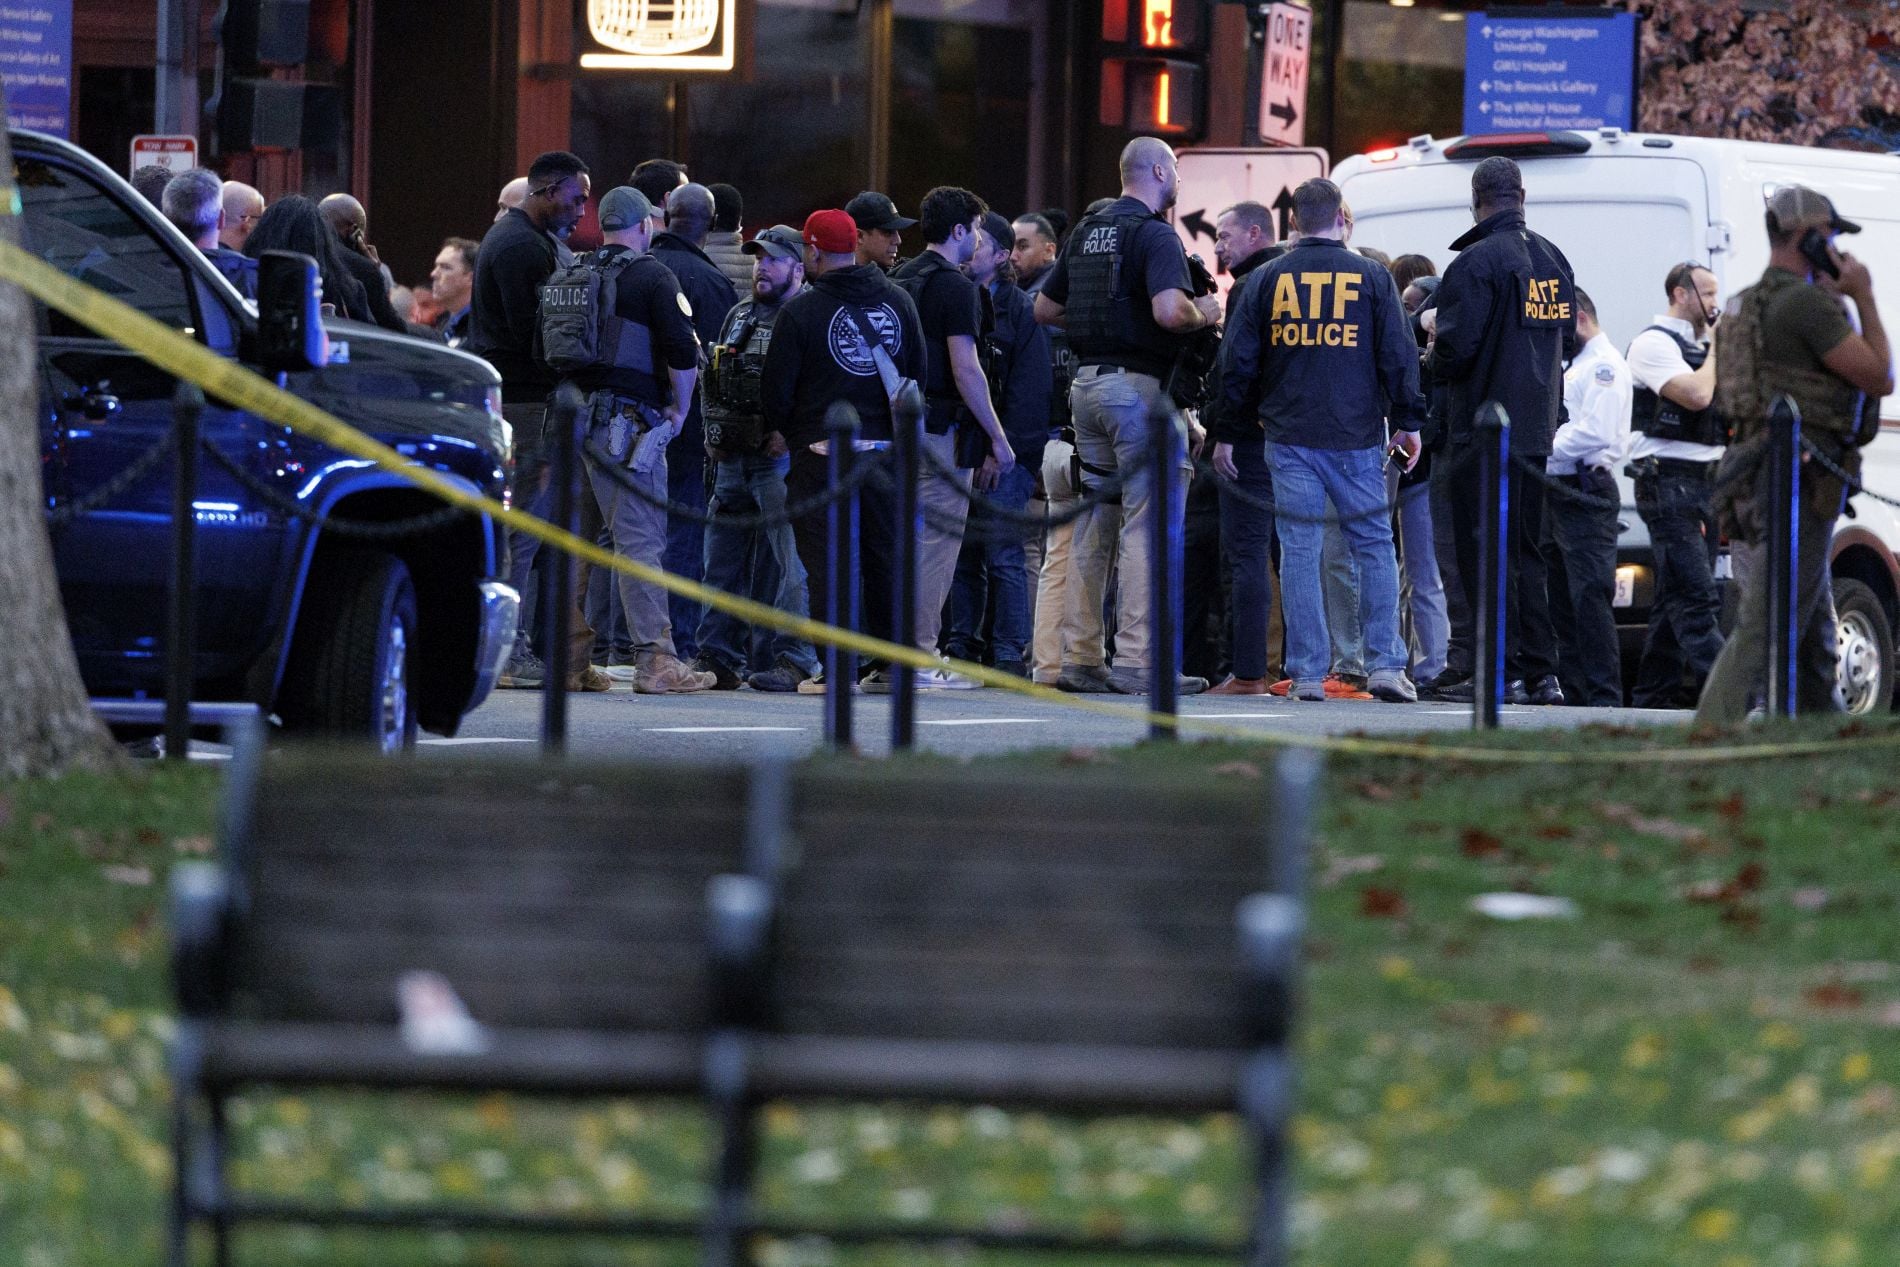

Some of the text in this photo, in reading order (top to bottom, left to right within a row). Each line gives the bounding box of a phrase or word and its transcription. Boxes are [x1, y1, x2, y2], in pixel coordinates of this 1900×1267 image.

[1274, 13, 1305, 50] ONE
[1494, 26, 1599, 42] George Washington
[1493, 40, 1548, 55] University
[1270, 51, 1304, 90] WAY
[1523, 60, 1567, 75] Hospital
[1494, 81, 1513, 93] The
[1560, 80, 1599, 96] Gallery
[1493, 101, 1582, 114] The White House
[1492, 116, 1605, 130] Historical Association
[1088, 227, 1118, 240] ATF
[1083, 239, 1118, 254] POLICE
[545, 288, 589, 306] POLICE
[1271, 272, 1363, 320] ATF
[1528, 278, 1560, 303] ATF
[1525, 301, 1571, 320] POLICE
[1271, 323, 1359, 347] POLICE
